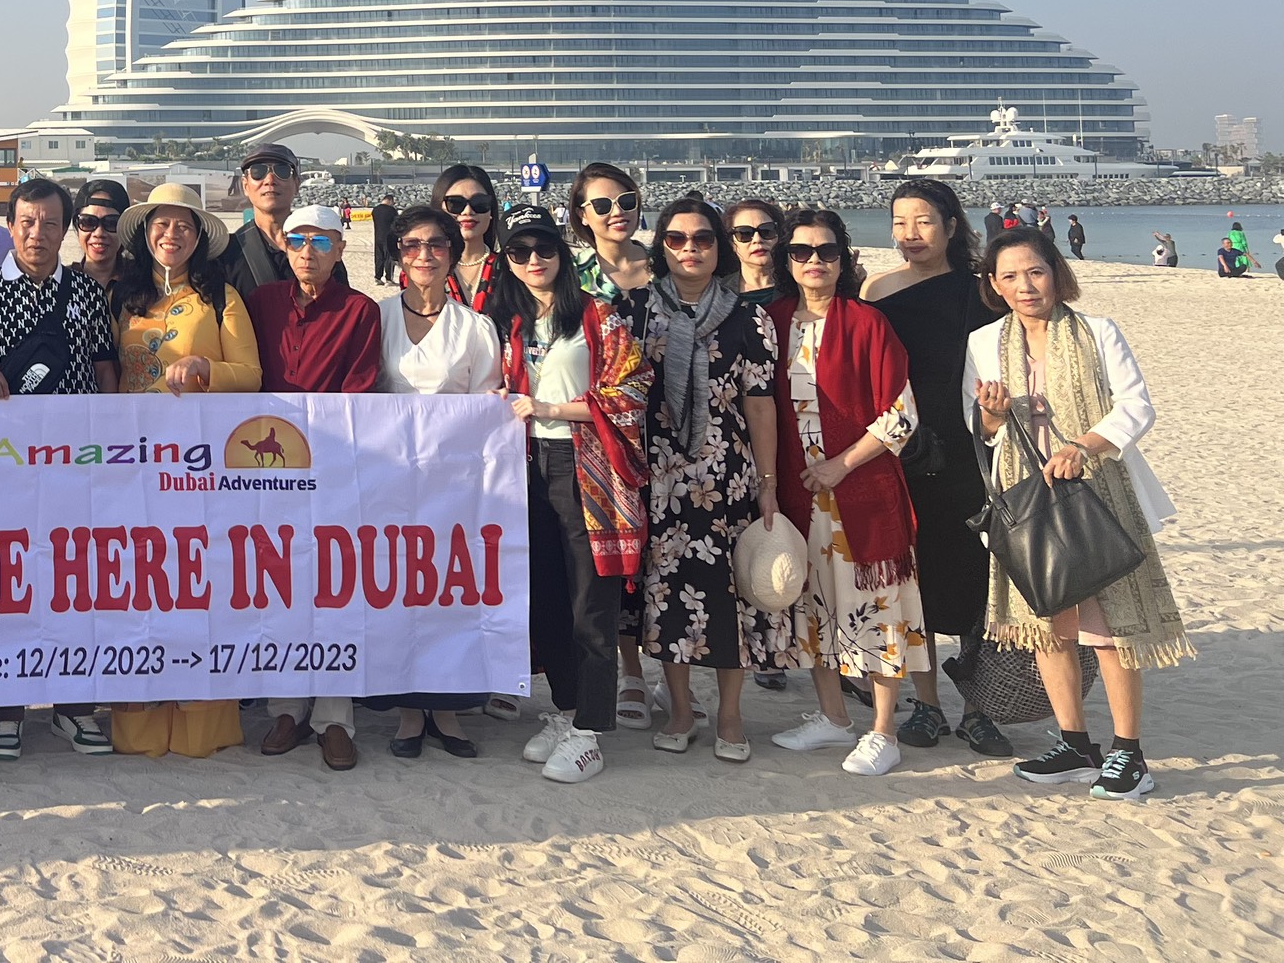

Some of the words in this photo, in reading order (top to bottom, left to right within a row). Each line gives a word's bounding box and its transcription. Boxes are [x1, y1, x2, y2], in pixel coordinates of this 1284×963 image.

[159, 471, 216, 492] Dubai
[218, 475, 317, 491] Adventures
[49, 525, 212, 613] HERE
[229, 524, 295, 610] IN
[314, 523, 504, 609] DUBAI
[16, 646, 166, 678] 12/12/2023
[209, 642, 358, 675] 17/12/2023
